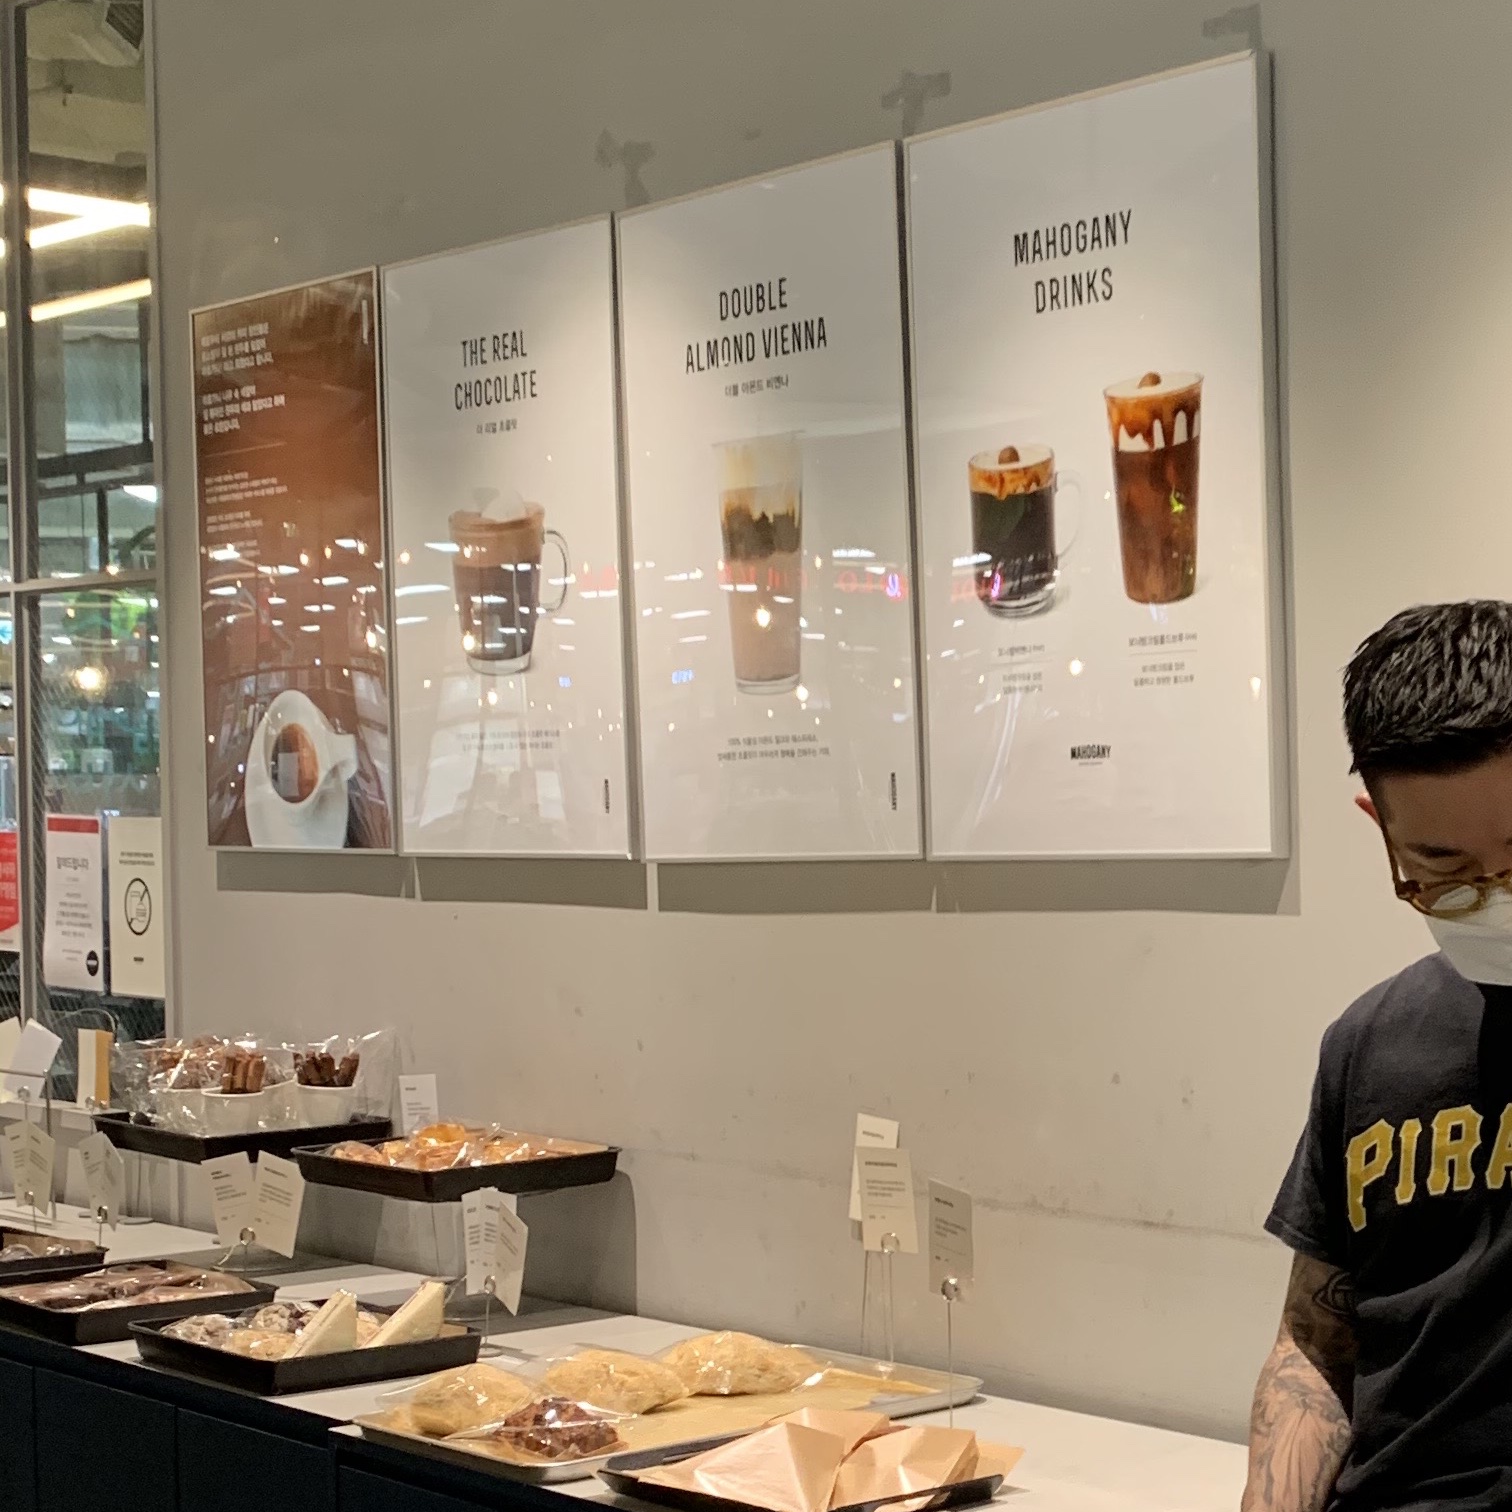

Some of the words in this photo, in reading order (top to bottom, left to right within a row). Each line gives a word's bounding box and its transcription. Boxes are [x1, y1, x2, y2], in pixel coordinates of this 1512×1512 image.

[1013, 208, 1131, 267] MAHOGANY
[719, 277, 788, 321] DOUBLE
[1034, 266, 1113, 314] DRINKS
[461, 336, 487, 367] THE
[492, 329, 527, 362] REAL
[686, 331, 756, 374] ALMOND
[762, 316, 827, 359] VIENNA
[454, 369, 538, 410] CHOCOLATE
